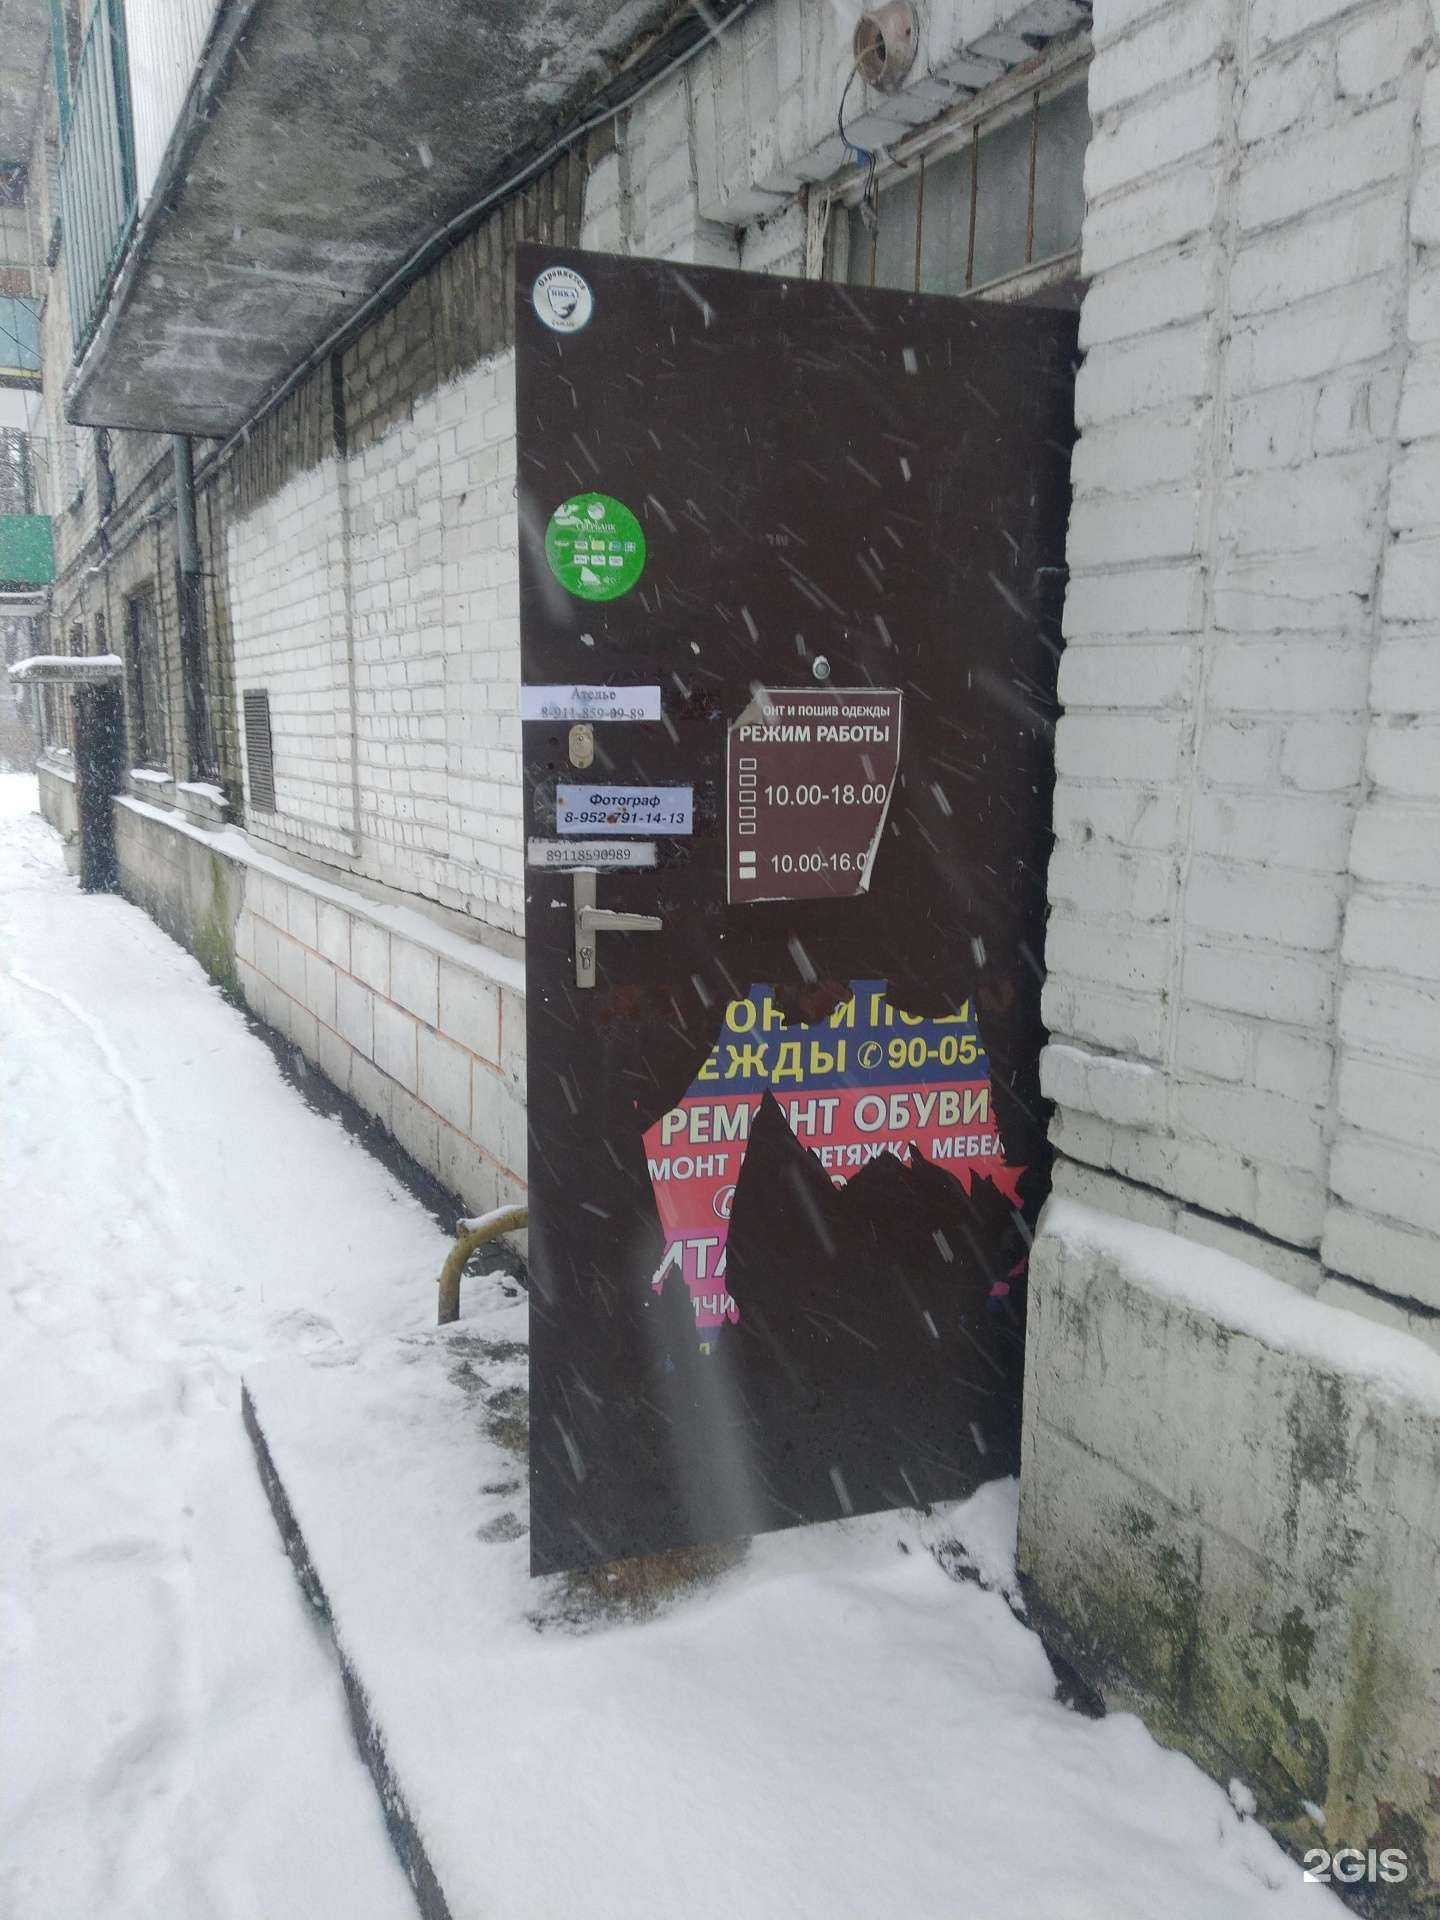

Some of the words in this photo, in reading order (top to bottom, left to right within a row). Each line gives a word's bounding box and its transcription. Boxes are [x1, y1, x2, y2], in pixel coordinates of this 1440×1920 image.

[571, 687, 617, 700] Ателье
[787, 705, 795, 716] И
[798, 705, 839, 717] ПОШИВ
[841, 705, 890, 719] ОДЕЖДЫ
[739, 725, 811, 743] РЕЖИМ
[817, 725, 889, 743] РАБОТЫ
[590, 794, 661, 808] Фотограф
[764, 784, 886, 805] 10.00-18.00
[564, 811, 685, 824] 8-952791-14-13
[546, 848, 631, 862] 89118590989
[771, 852, 870, 873] 10.00-16.0
[725, 997, 809, 1034] ОН
[661, 1098, 840, 1146] РЕМНТ
[854, 1088, 990, 1133] ОБУВИ
